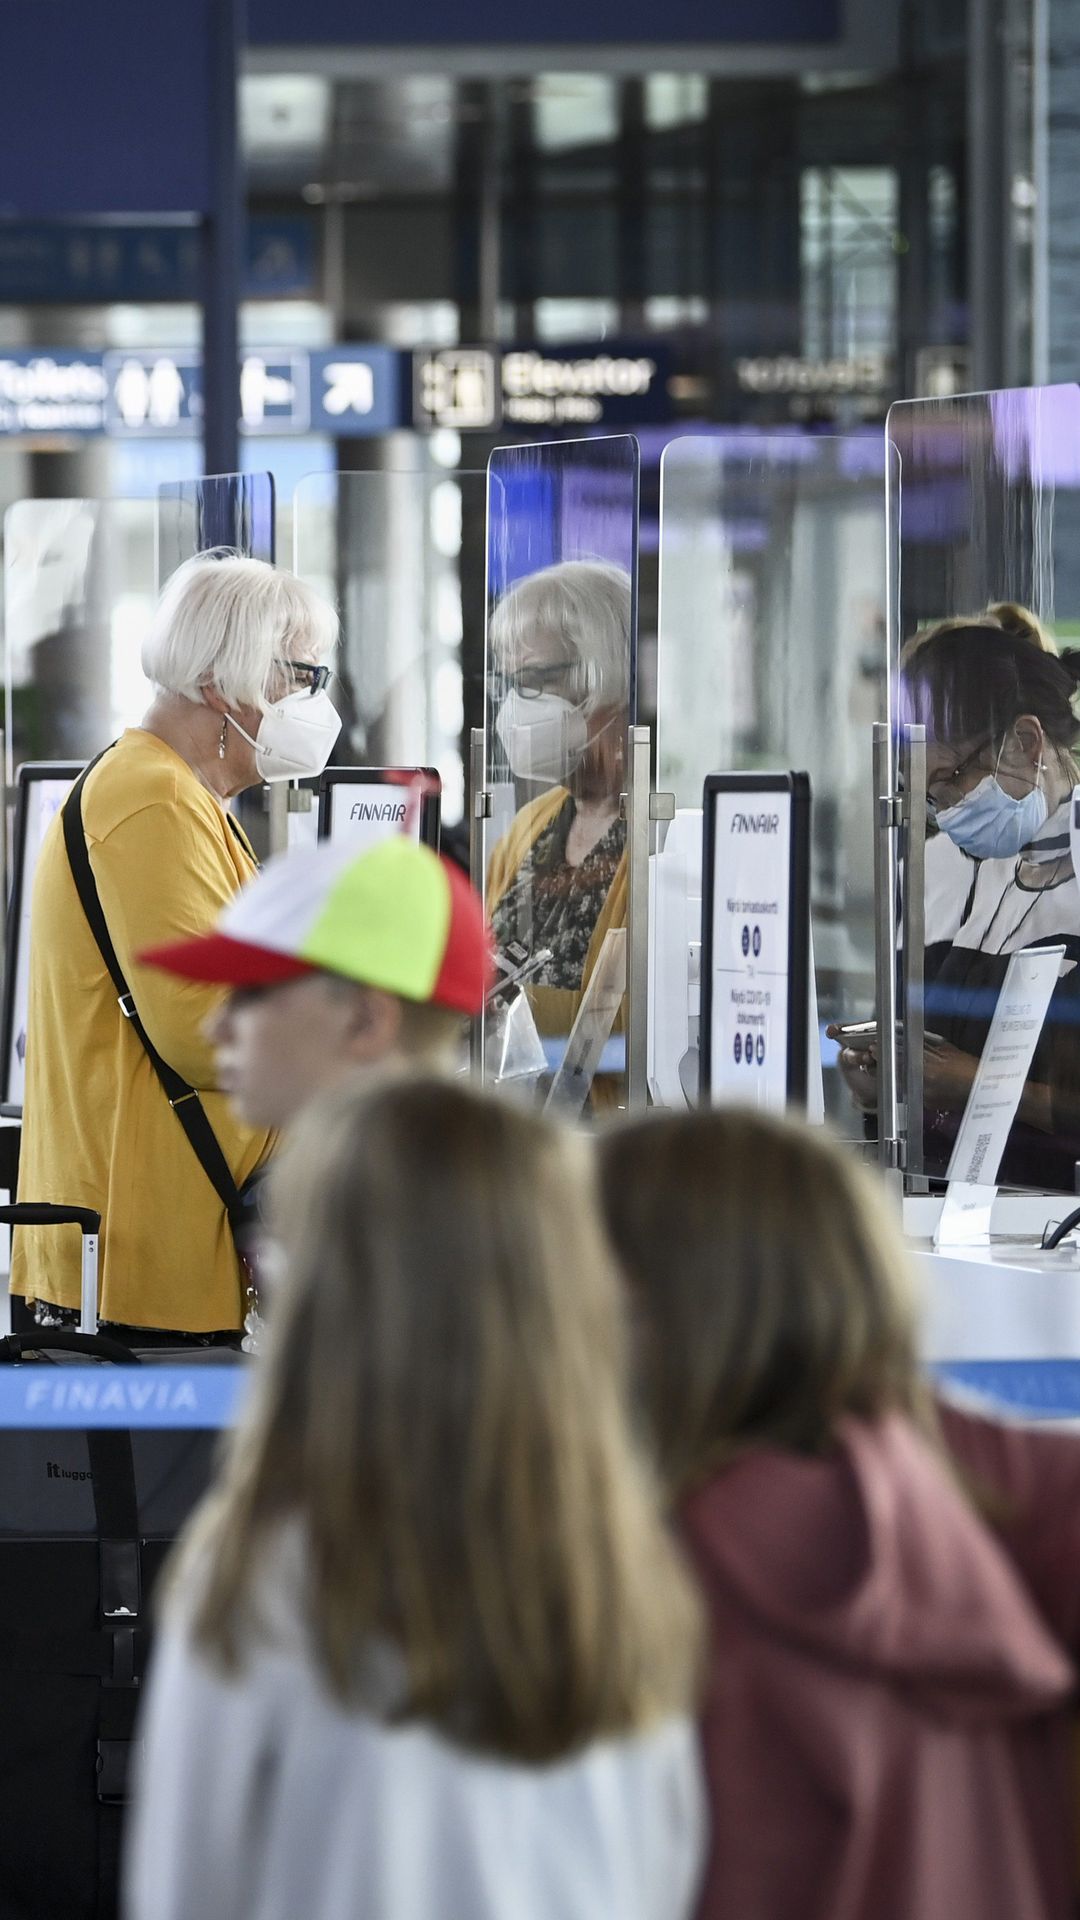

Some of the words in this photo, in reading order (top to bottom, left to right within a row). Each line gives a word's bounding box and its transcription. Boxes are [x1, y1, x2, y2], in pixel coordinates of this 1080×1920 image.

[502, 352, 655, 396] Elevator
[350, 803, 406, 822] FINNAIR
[730, 813, 780, 834] FINNAIR
[24, 1379, 199, 1411] FINAVIA
[46, 1461, 61, 1479] it
[61, 1468, 94, 1481] lugga
